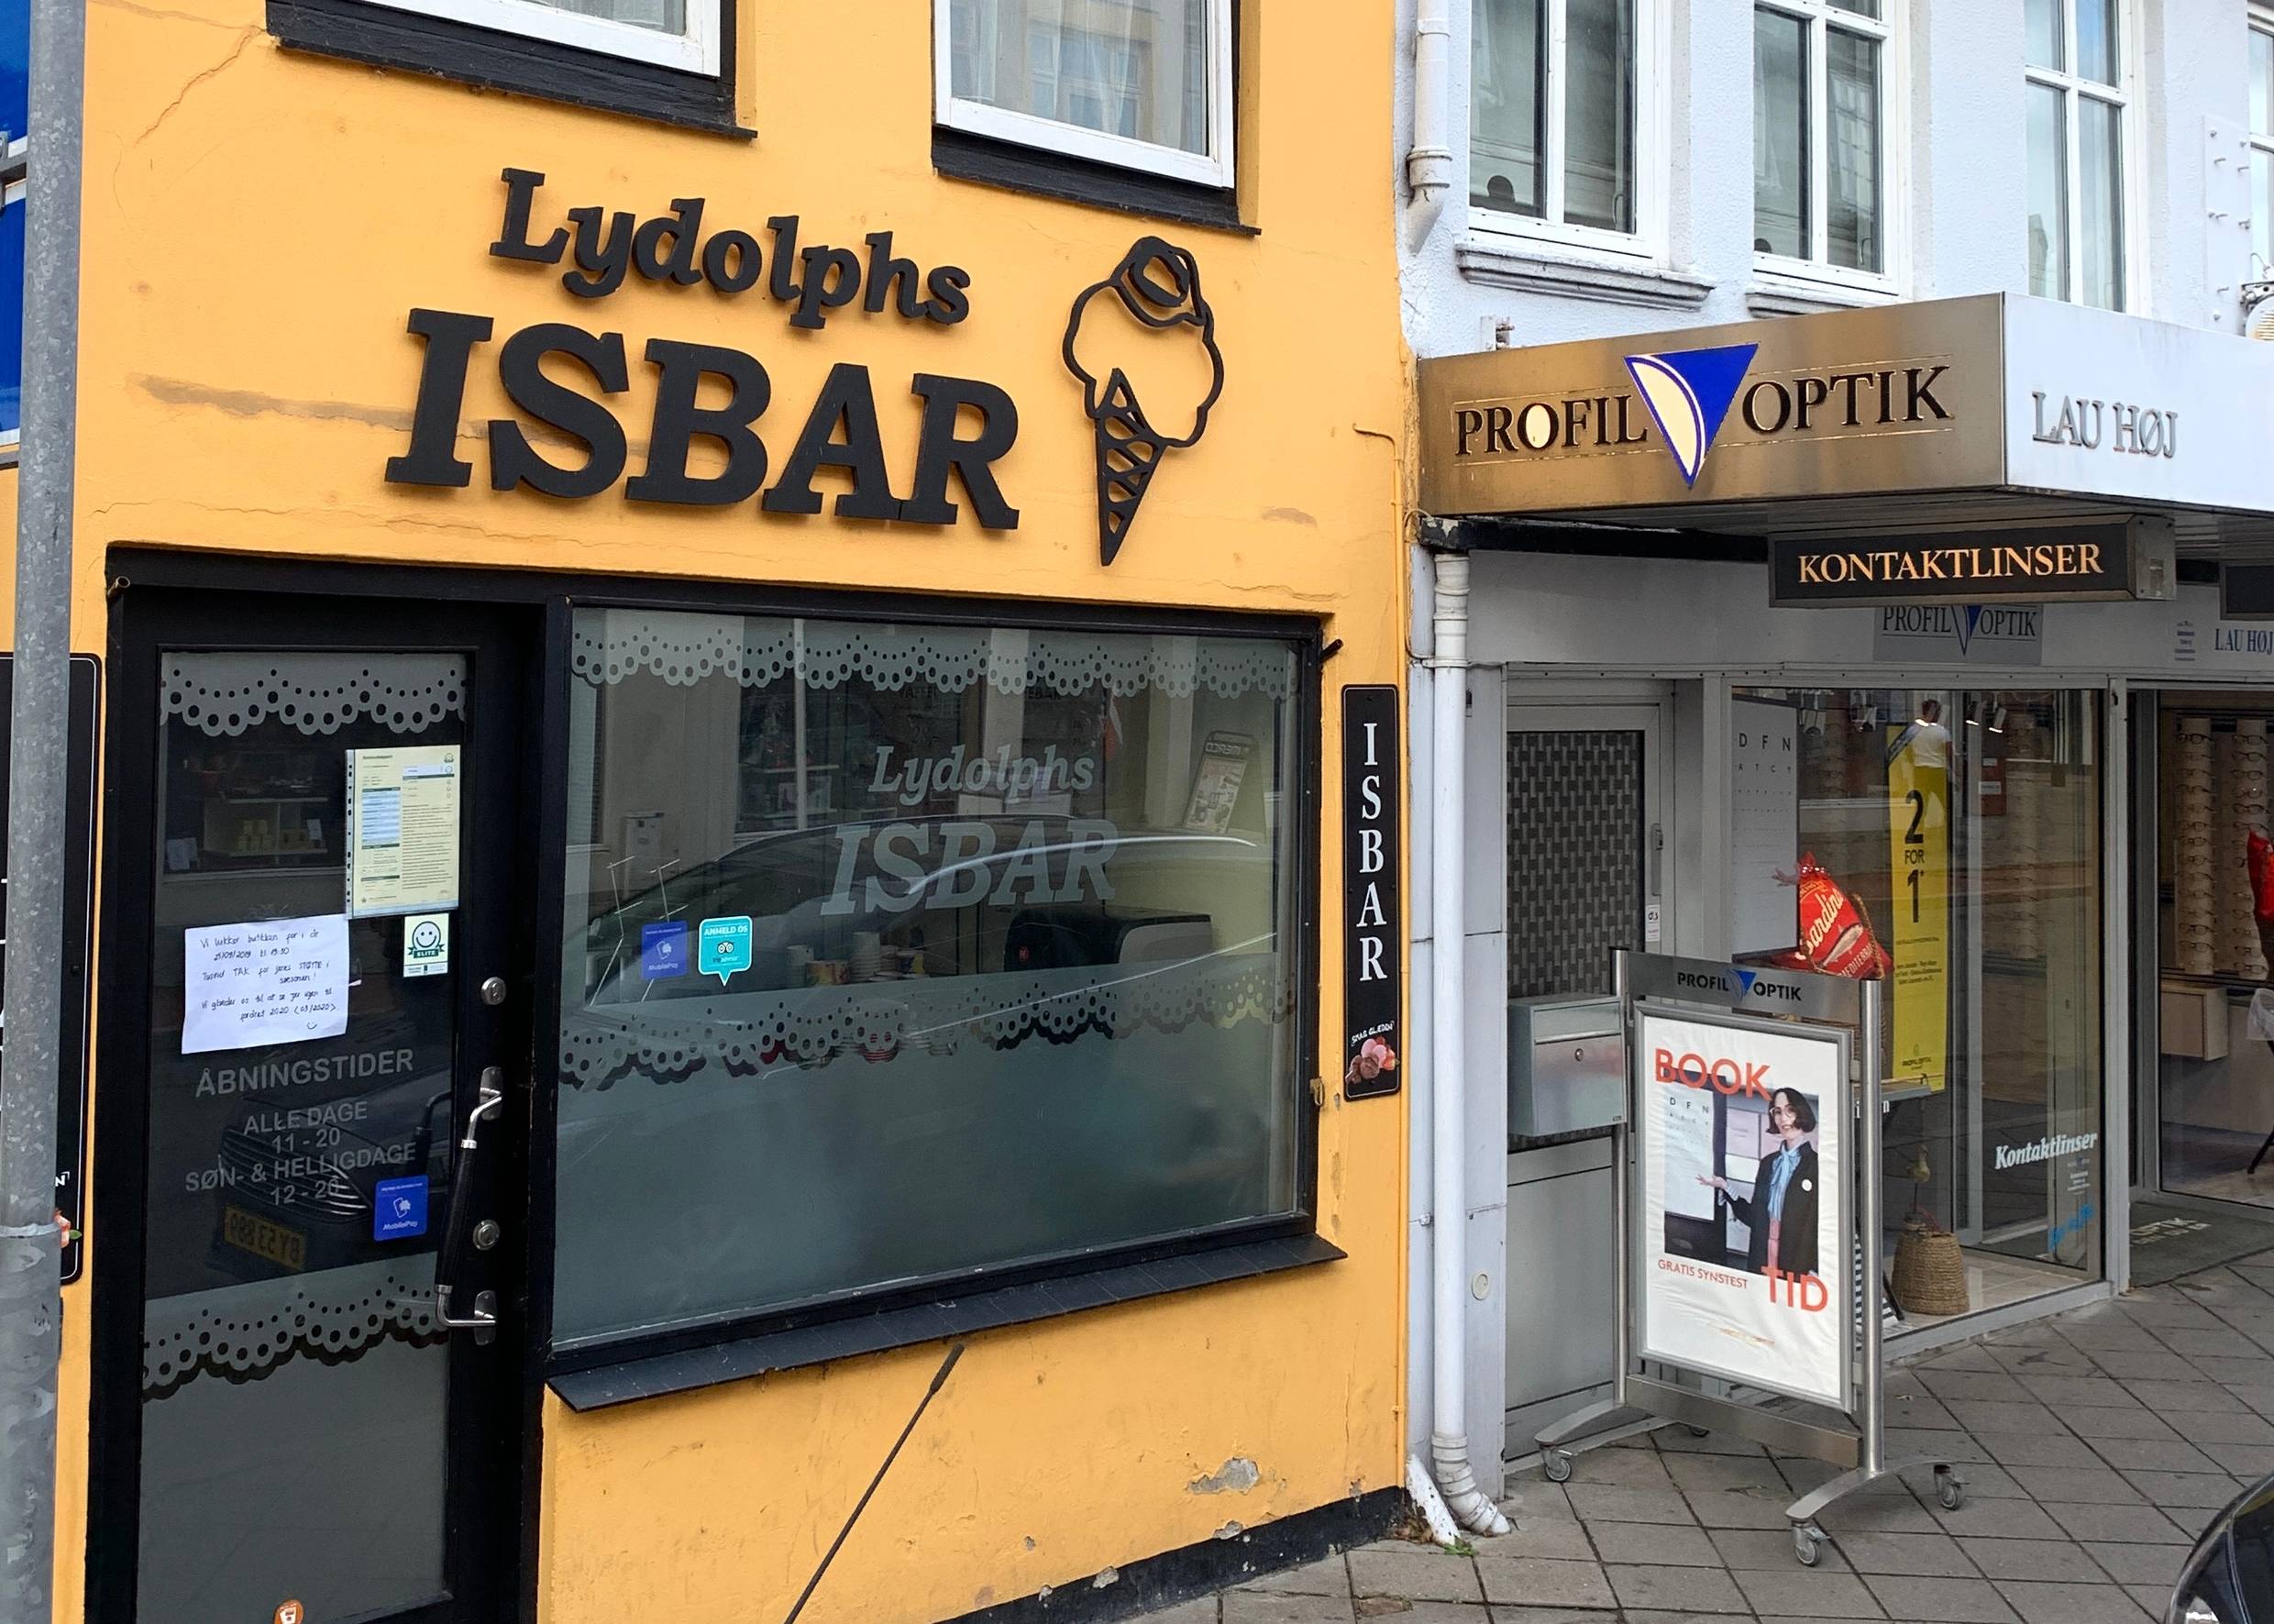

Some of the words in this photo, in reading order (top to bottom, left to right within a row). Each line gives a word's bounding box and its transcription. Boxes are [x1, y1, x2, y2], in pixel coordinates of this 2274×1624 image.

[489, 167, 971, 330] Lydolphs
[385, 307, 1020, 530] ISBAR
[1455, 393, 1649, 457] PROFIL
[1742, 365, 1951, 434] OPTIK
[2032, 392, 2103, 449] LAU
[2112, 402, 2178, 458] HØJ
[1797, 543, 2103, 584] KONTAKTLINSER
[1882, 605, 1951, 633] PROFIL
[1981, 610, 2037, 636] OPTIK
[2215, 629, 2244, 650] LAU
[2246, 630, 2273, 655] HØJ
[1739, 733, 1748, 748] D
[1761, 735, 1769, 750] F
[1782, 737, 1791, 752] N
[868, 744, 1096, 807] Lydolphs
[1904, 790, 1925, 845] 2
[820, 820, 1118, 917] ISBAR
[1356, 723, 1387, 982] ISBAR
[1904, 849, 1925, 865] FOR
[200, 939, 209, 948] Vi
[704, 925, 736, 935] ANMELD
[738, 924, 748, 933] OS
[233, 967, 249, 977] TAK
[1677, 972, 1729, 991] PROFIL
[1753, 982, 1802, 1000] OPTIK
[195, 1048, 414, 1098] ÅBNINGSTIDER
[1655, 1048, 1772, 1100] BOOK
[243, 1110, 301, 1135] ALLE
[307, 1101, 368, 1126] DAGE
[272, 1132, 294, 1154] 11
[315, 1127, 340, 1147] 20
[1995, 1132, 2097, 1170] Kontaktlinser
[185, 1166, 244, 1192] SØN-
[251, 1163, 267, 1183] &
[274, 1143, 416, 1179] HELLIGDAGE
[270, 1185, 295, 1206] 12
[315, 1176, 339, 1199] 20
[1658, 1259, 1695, 1276] GRATIS
[1697, 1268, 1748, 1288] SYNSTEST
[1761, 1265, 1828, 1312] TID
